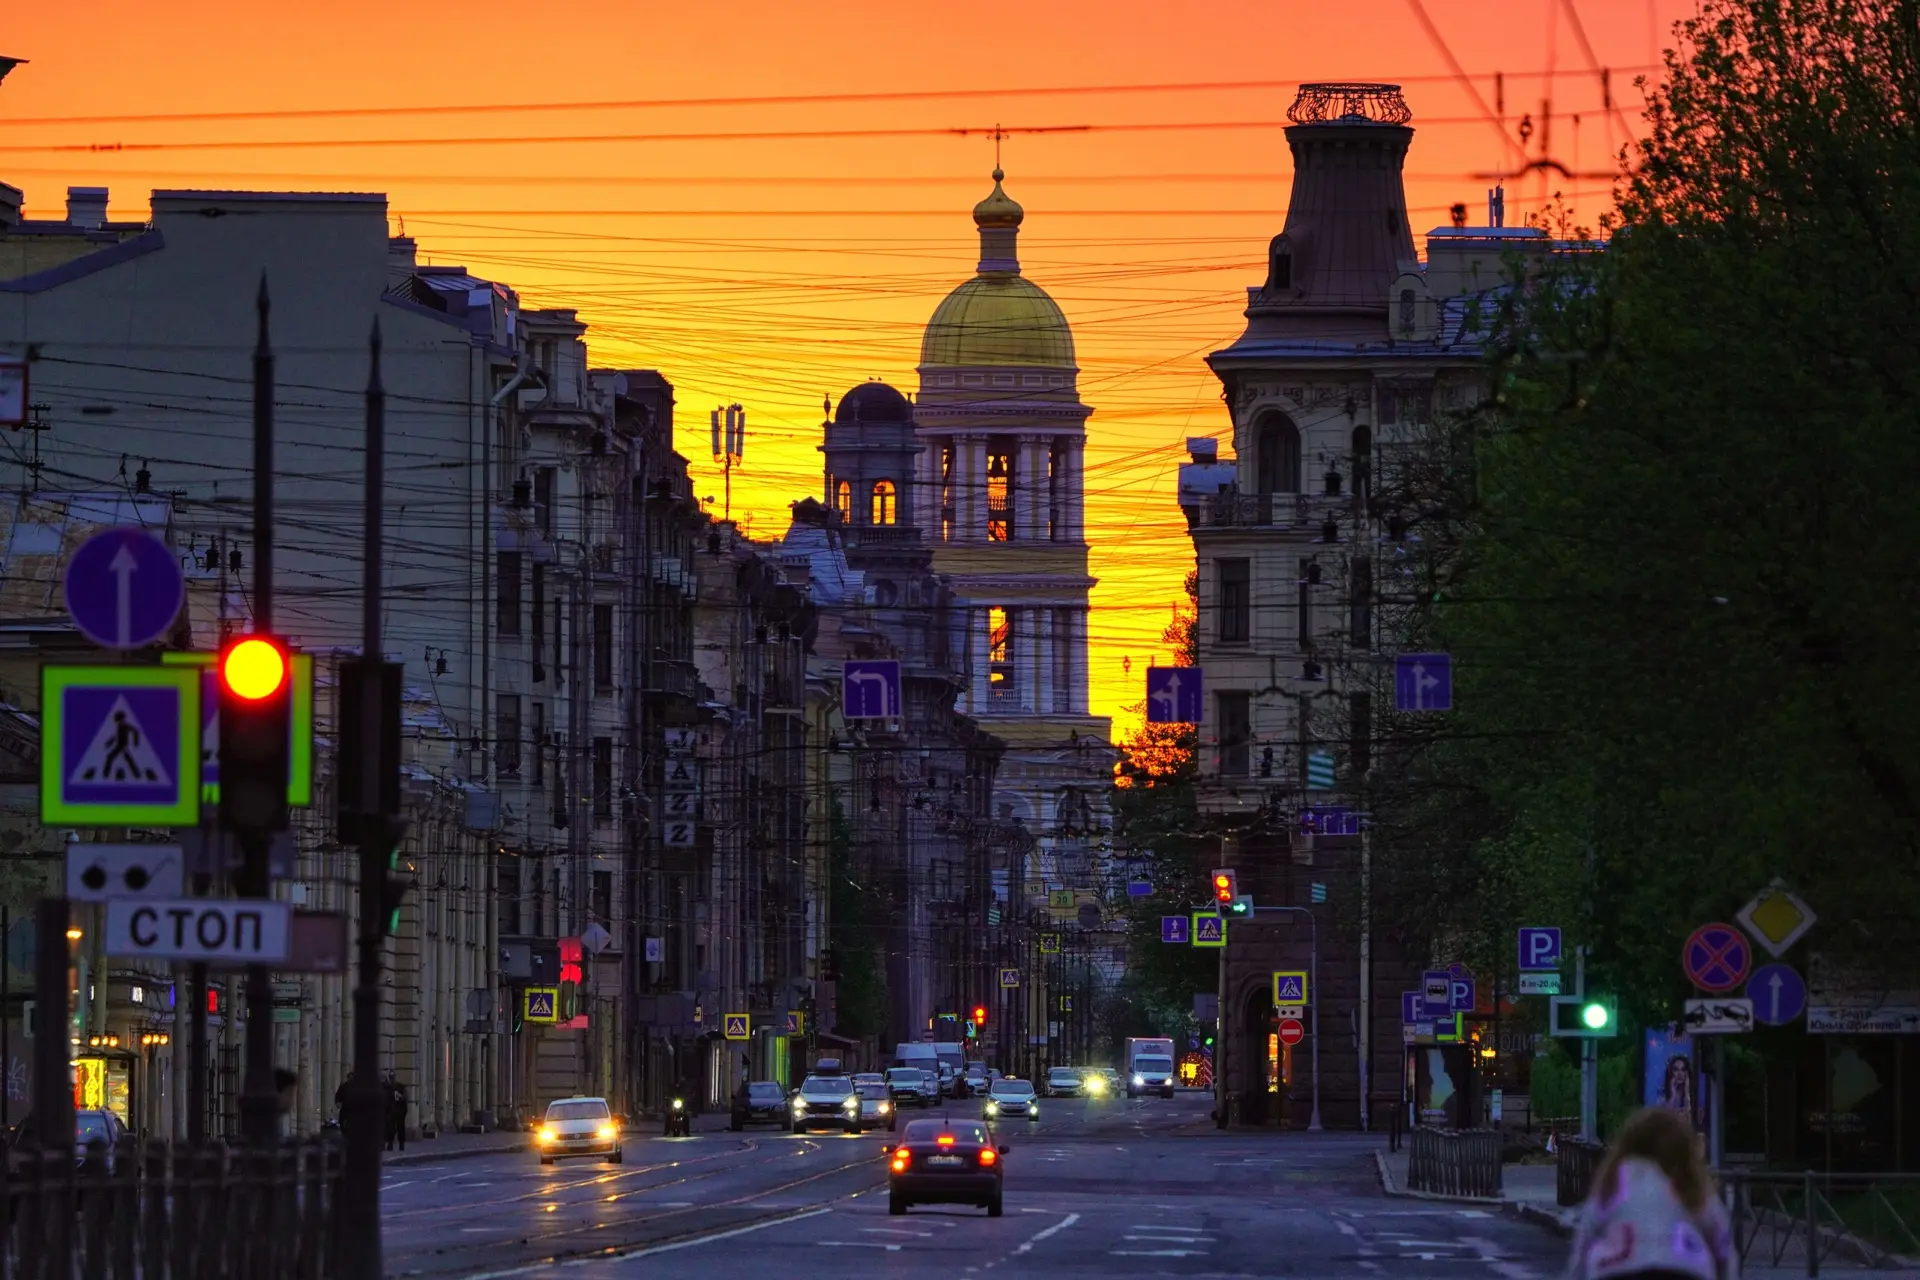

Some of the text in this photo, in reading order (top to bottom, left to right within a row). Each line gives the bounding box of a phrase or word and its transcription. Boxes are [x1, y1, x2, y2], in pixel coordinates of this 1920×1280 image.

[671, 731, 690, 841] JAZZ
[130, 905, 263, 951] СТОП
[1530, 932, 1553, 965] P
[1452, 982, 1469, 1007] P
[1810, 1019, 1845, 1030] Юных
